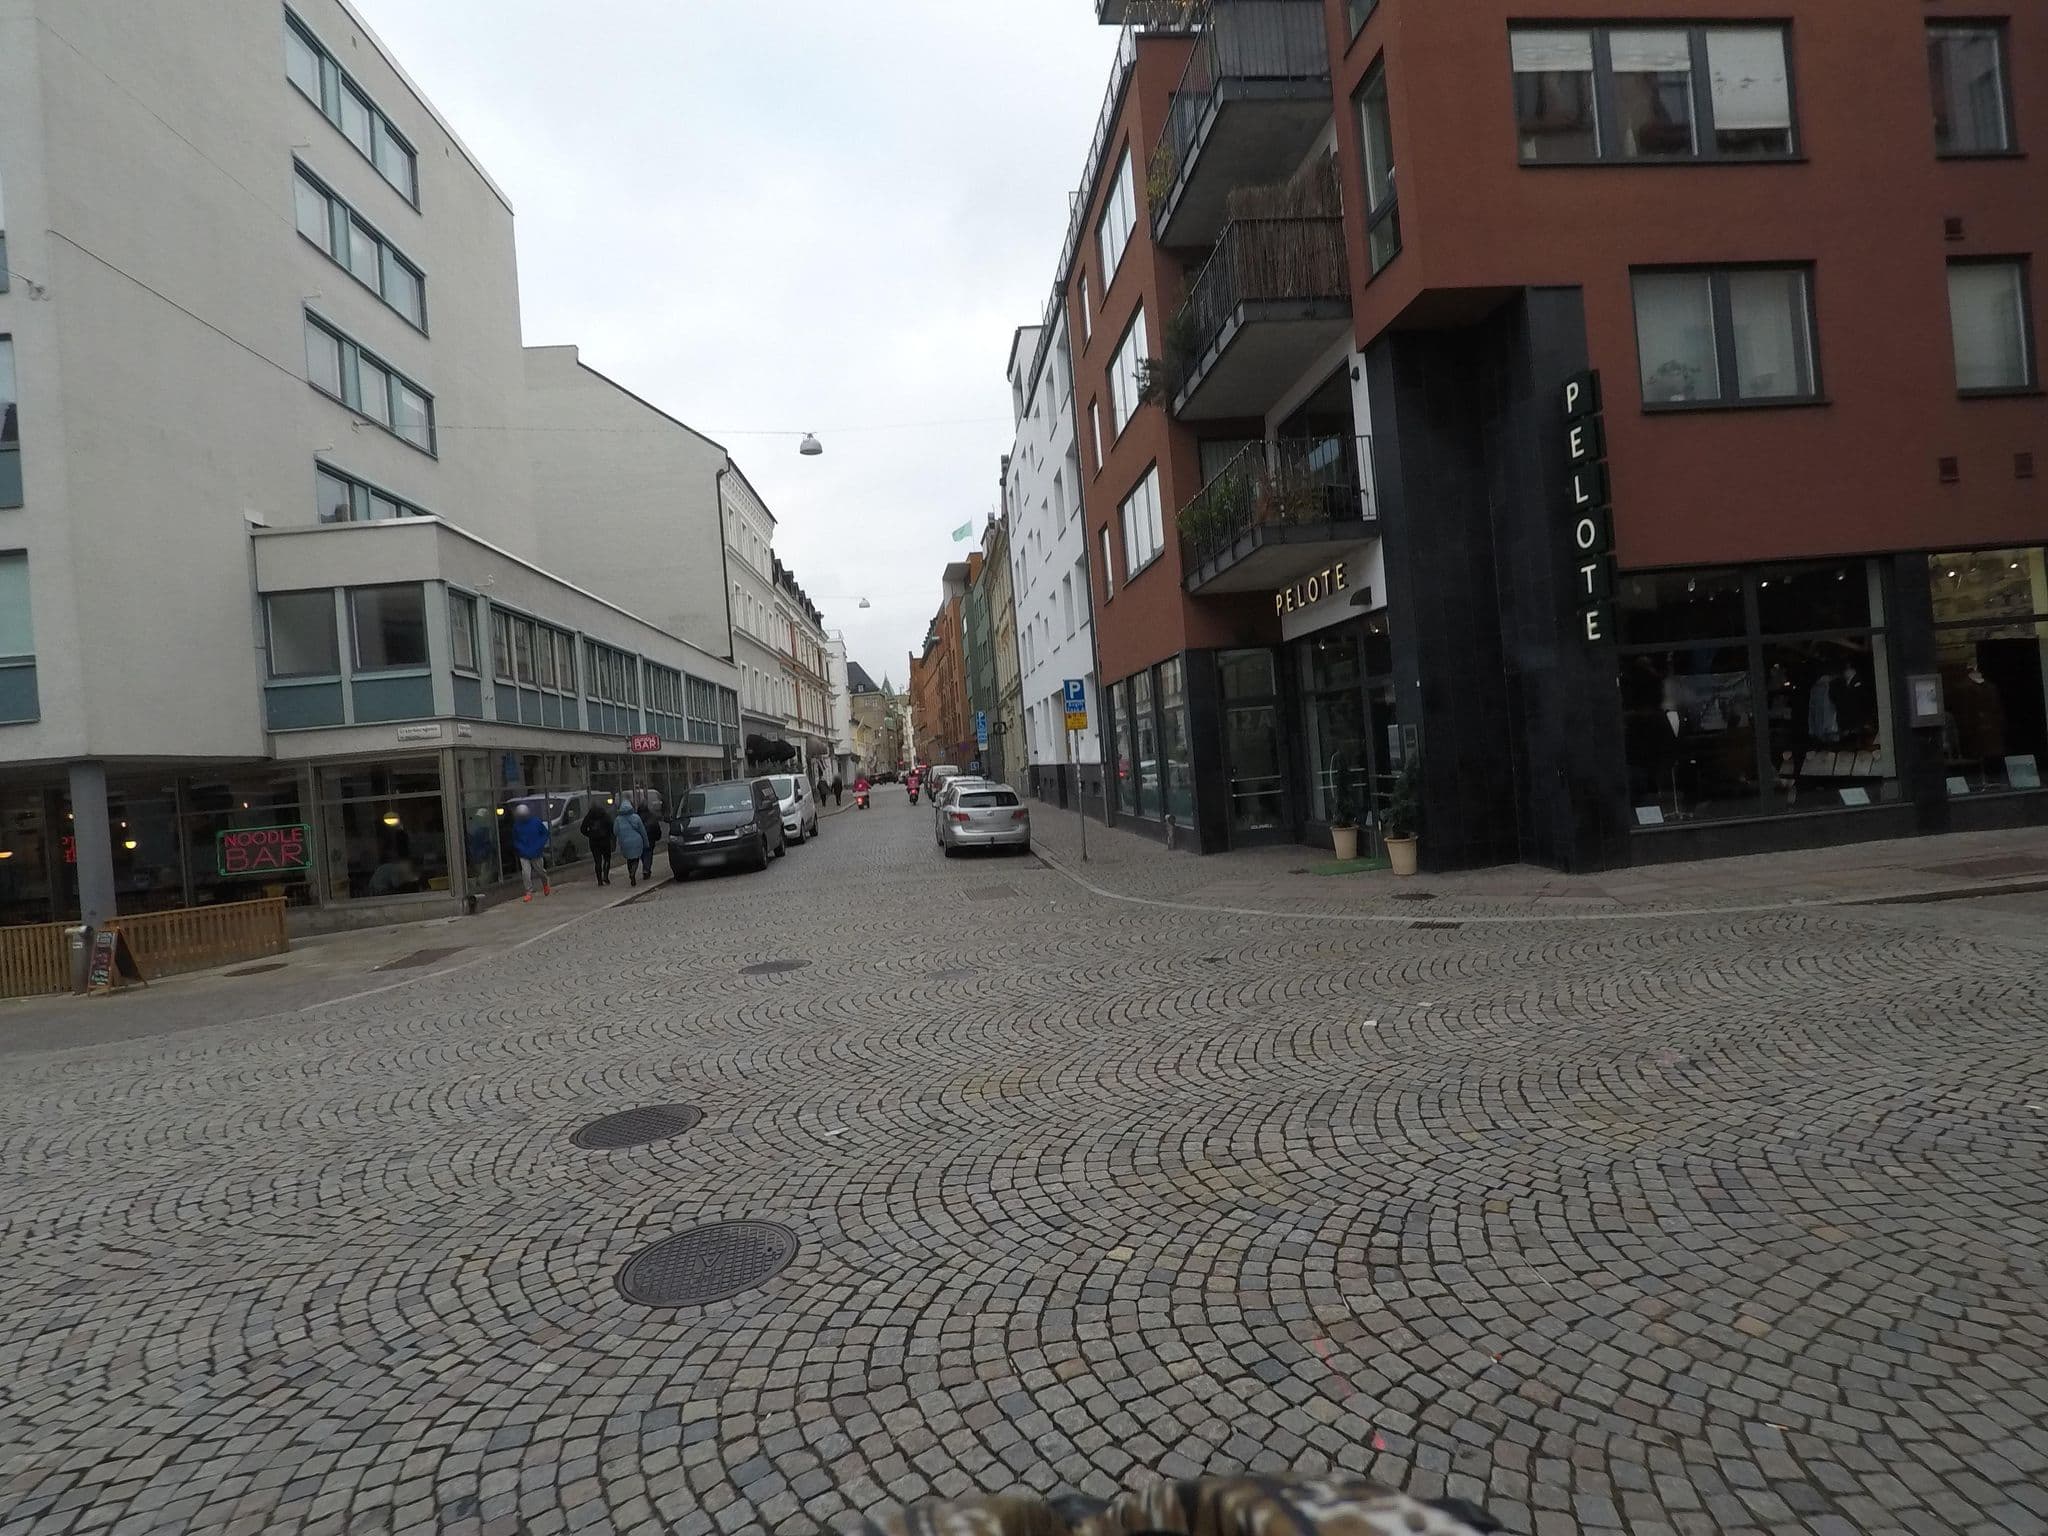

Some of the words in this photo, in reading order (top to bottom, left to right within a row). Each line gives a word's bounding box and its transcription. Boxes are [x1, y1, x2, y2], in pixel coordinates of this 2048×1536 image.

[1566, 381, 1601, 641] PELOTE
[1275, 562, 1346, 617] PELOTE
[1069, 681, 1080, 699] P
[635, 740, 658, 751] BAR
[224, 828, 304, 848] NOODLE
[226, 843, 305, 871] BAR
